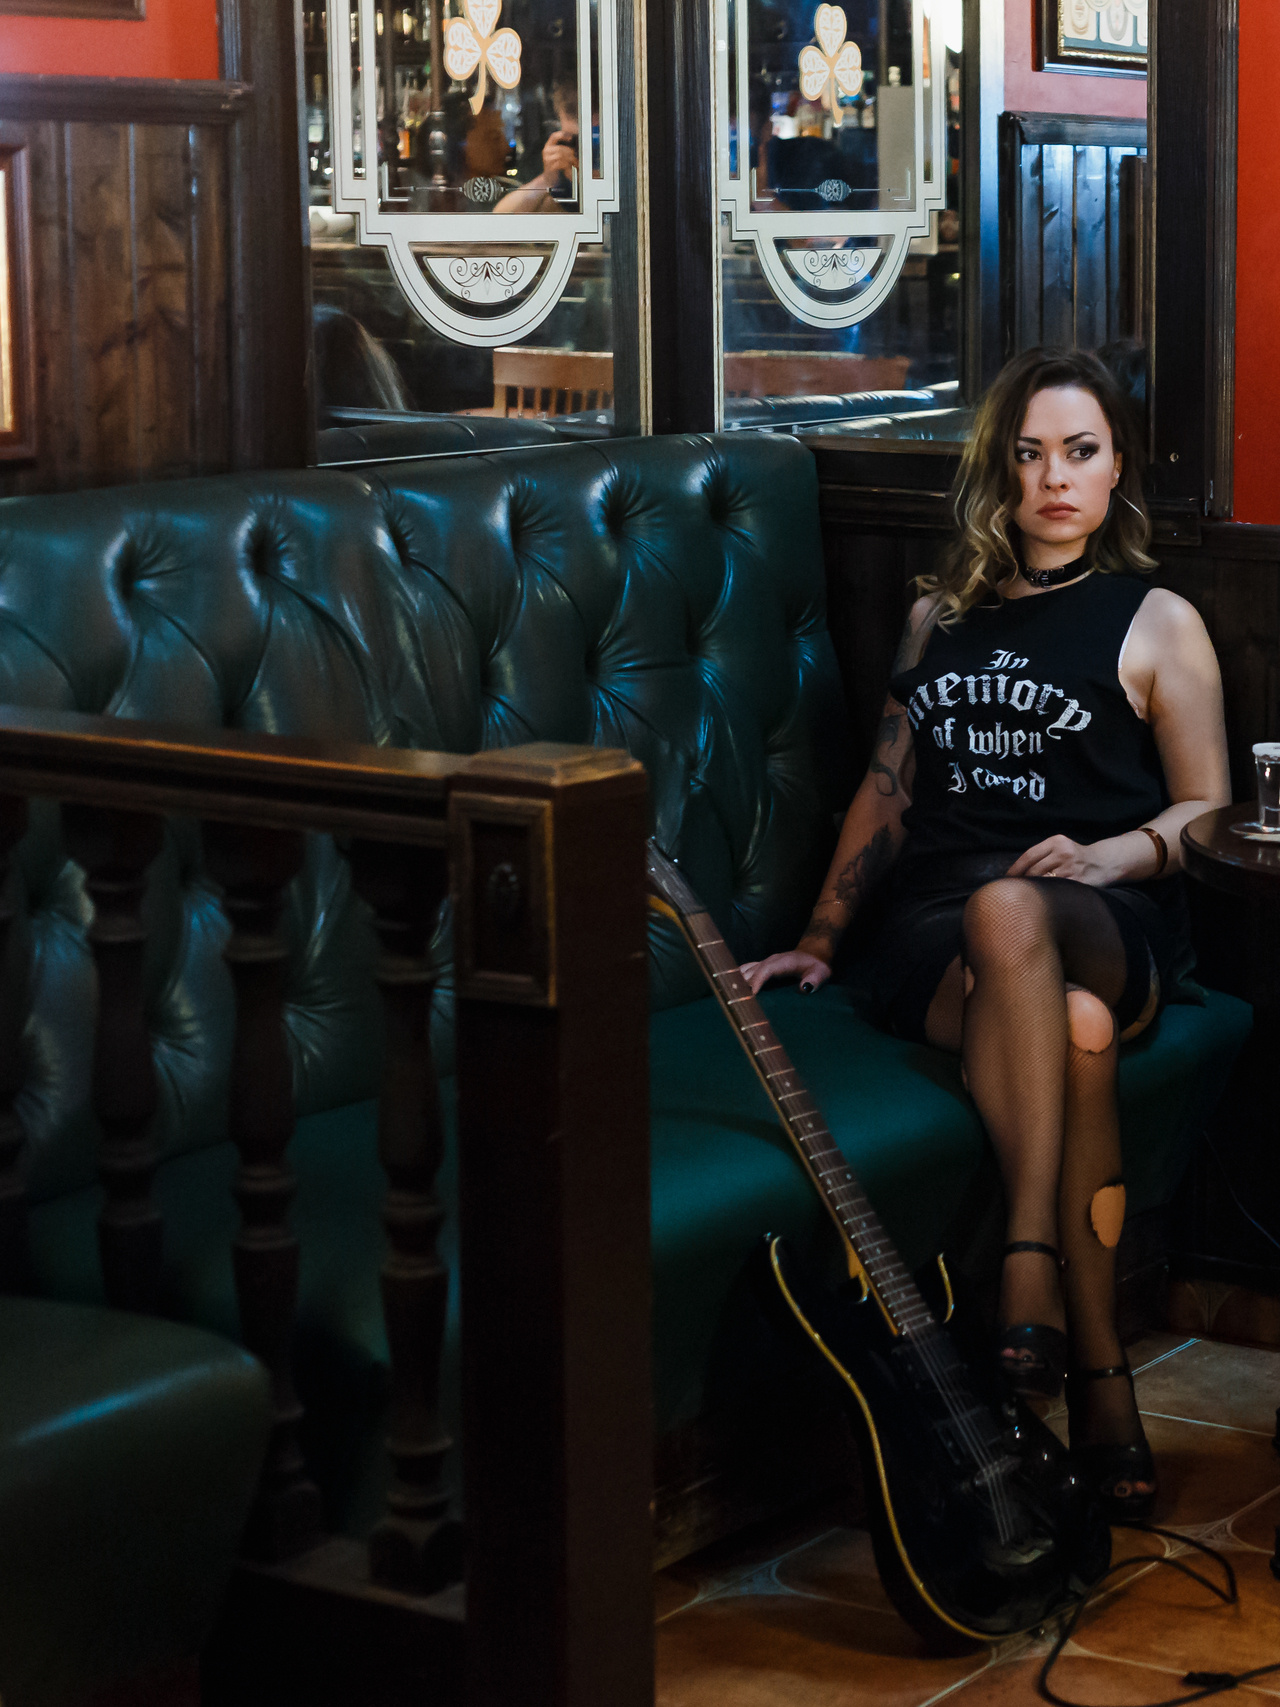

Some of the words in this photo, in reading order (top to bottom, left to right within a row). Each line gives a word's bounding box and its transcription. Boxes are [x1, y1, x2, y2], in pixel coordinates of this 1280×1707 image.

[980, 649, 1030, 670] In
[932, 717, 956, 750] of
[967, 721, 1045, 760] when
[947, 762, 968, 793] I
[971, 767, 1046, 802] cared
